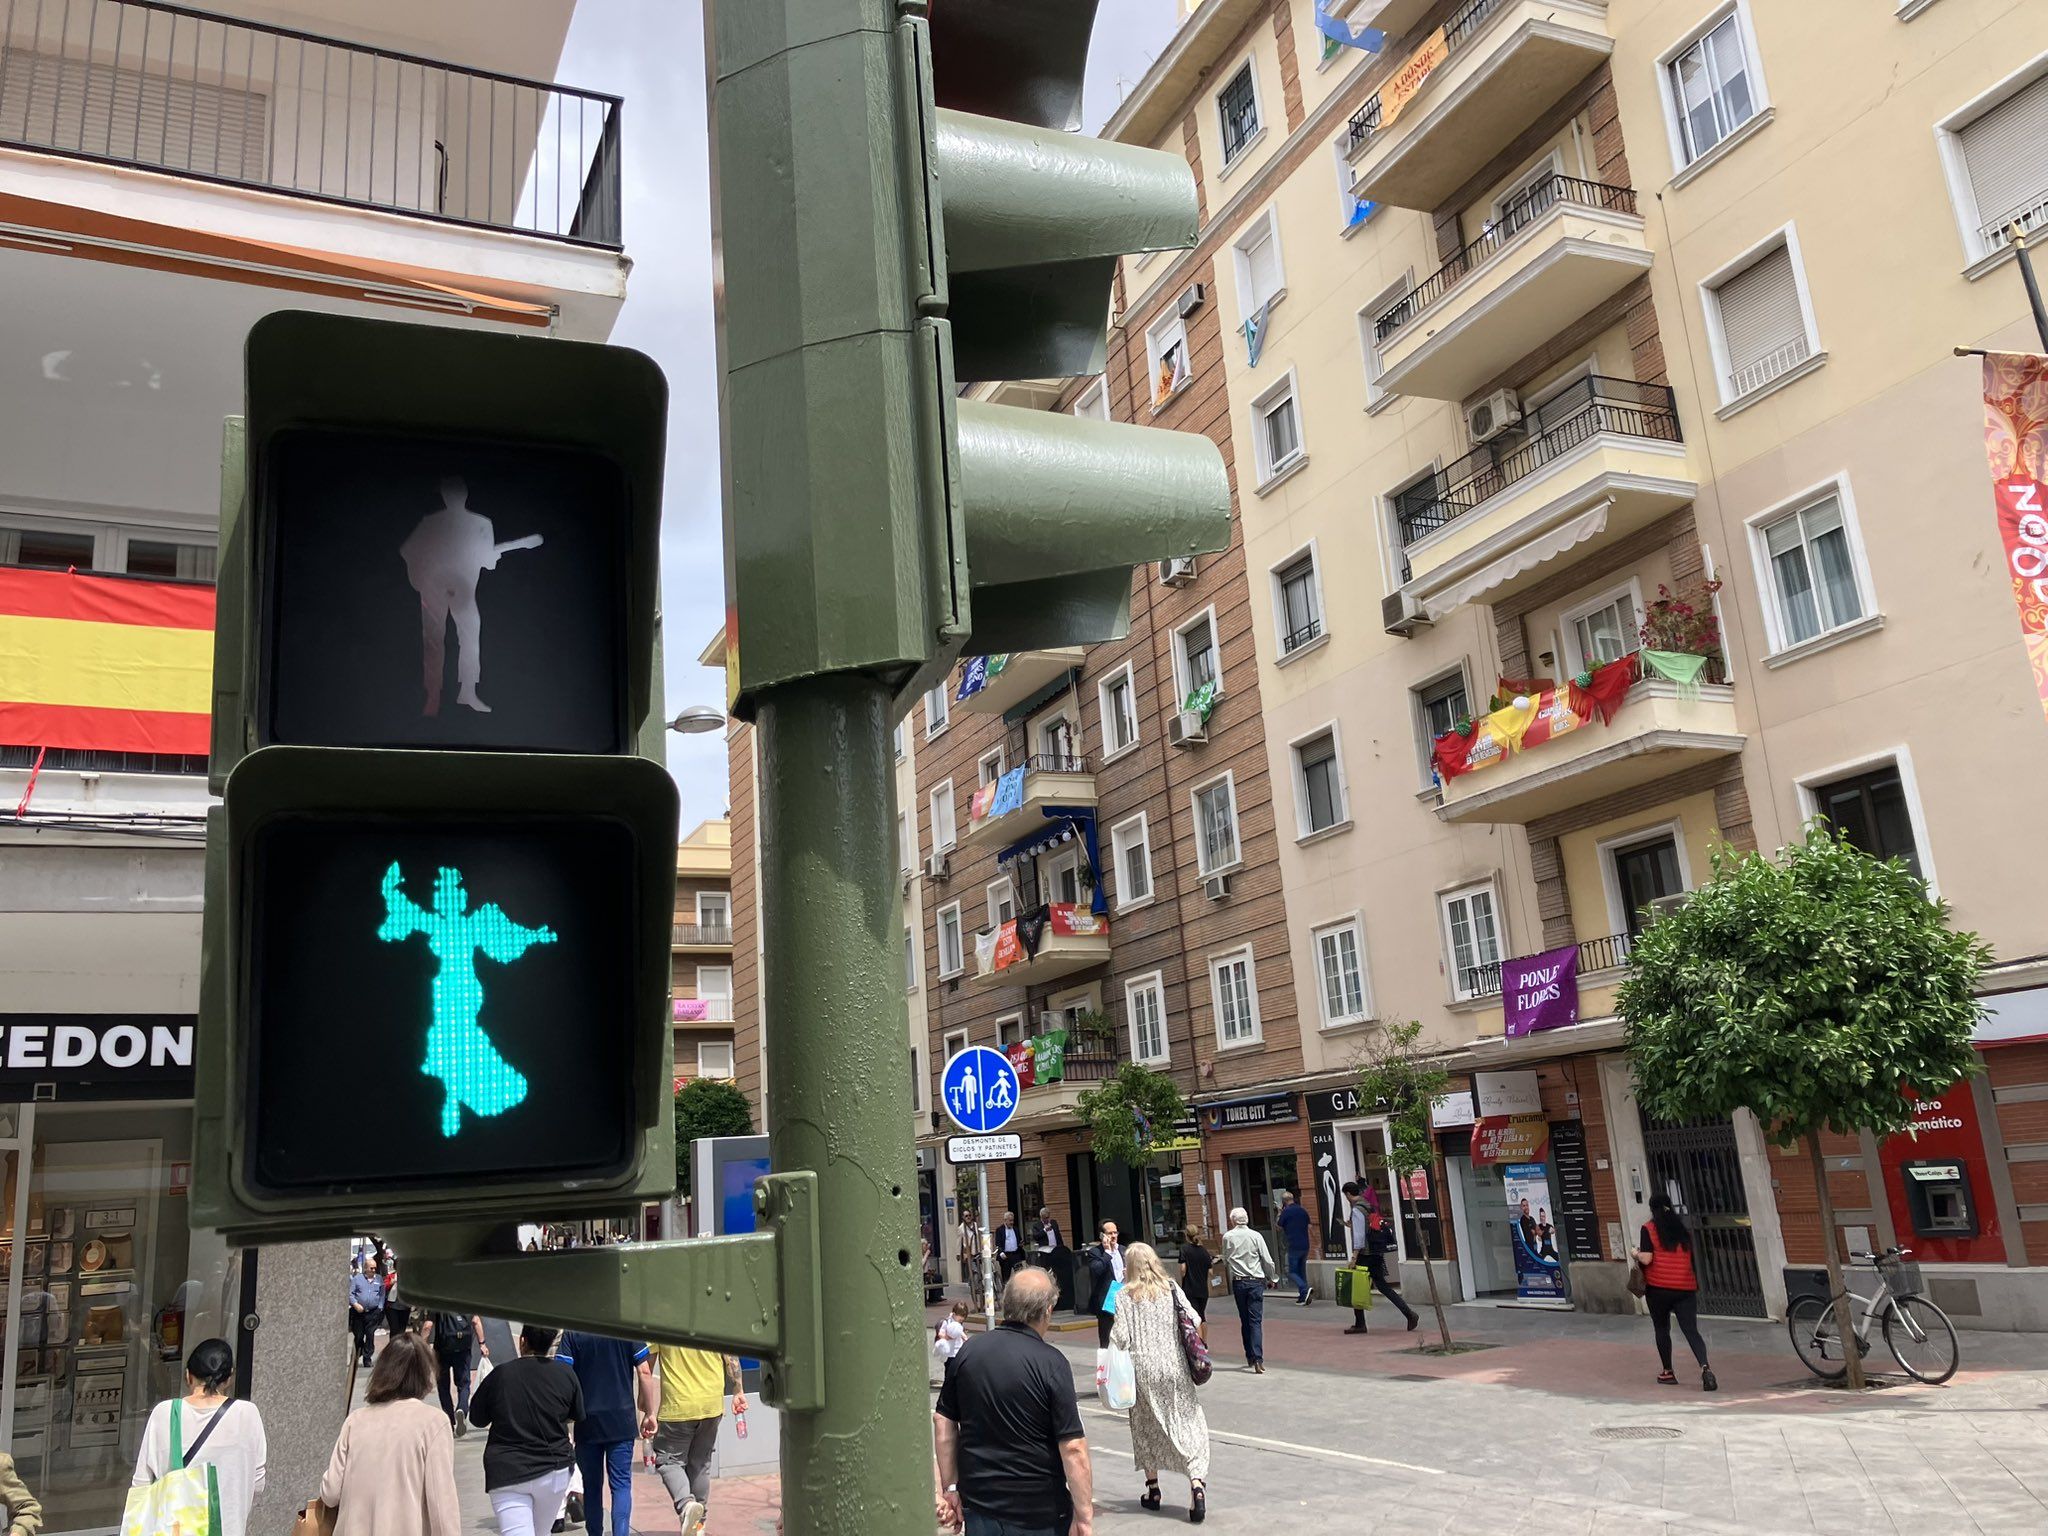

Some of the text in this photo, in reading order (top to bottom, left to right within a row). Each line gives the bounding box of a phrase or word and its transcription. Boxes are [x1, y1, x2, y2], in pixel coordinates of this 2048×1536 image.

[1519, 965, 1560, 990] PONLE
[0, 1025, 194, 1068] EDON
[1331, 1091, 1387, 1111] GAA
[1225, 1106, 1248, 1122] TONER
[1249, 1104, 1266, 1120] CITY
[952, 1145, 975, 1153] CICLOS
[985, 1143, 1017, 1151] PATINETES
[963, 1137, 995, 1145] DESMONTE
[1313, 1135, 1333, 1144] GALA
